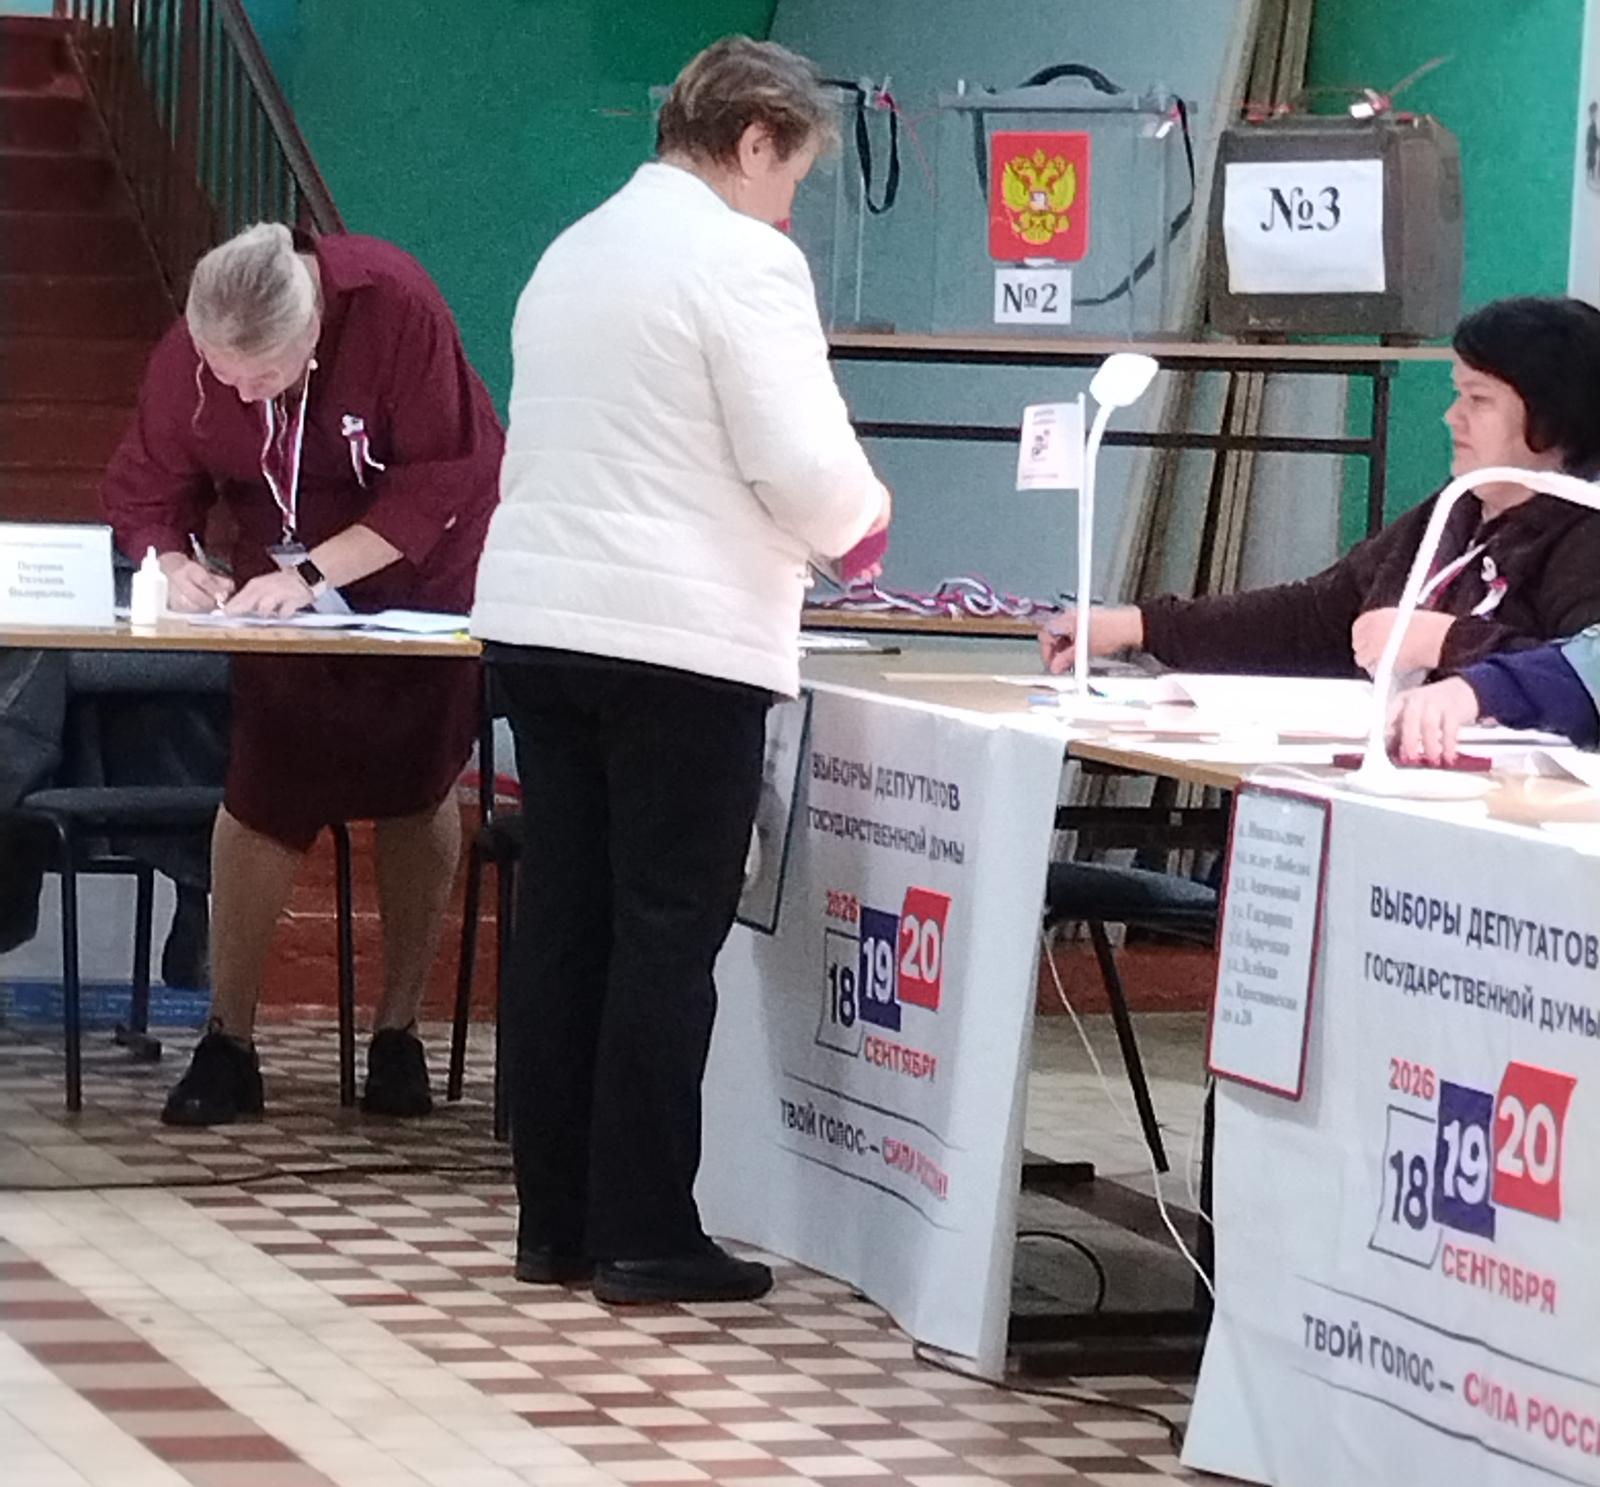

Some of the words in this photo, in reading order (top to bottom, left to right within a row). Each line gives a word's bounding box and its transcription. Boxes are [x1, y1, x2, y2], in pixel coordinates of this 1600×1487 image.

[1260, 186, 1342, 233] №3
[1002, 282, 1058, 314] №2
[812, 752, 873, 791] ВЫБОРЫ
[875, 766, 961, 812] ДЕПУТАТОВ
[807, 805, 926, 855] ГОСУДАРСТВЕННОЙ
[928, 834, 965, 865] ДУМЫ
[1370, 884, 1462, 937] ВЫБОРЫ
[1466, 907, 1599, 970] ДЕПУТАТОВ
[828, 963, 856, 1028] 18
[863, 936, 893, 1004] 19
[900, 915, 940, 984] 20
[1364, 952, 1534, 1023] ГОСУДАРСТВЕННОЙ
[1540, 997, 1600, 1040] ДУМЫ
[1388, 1057, 1435, 1101] 2026
[779, 1097, 817, 1136] ТВОЙ
[1389, 1150, 1429, 1231] 18
[1443, 1119, 1488, 1205] 19
[1496, 1095, 1557, 1185] 20
[1441, 1244, 1557, 1315] СЕНТЯБРЯ
[1303, 1313, 1364, 1364] ТВОЙ
[1369, 1334, 1435, 1392] ГОЛОС
[1463, 1372, 1519, 1427] СИЛА
[1527, 1397, 1600, 1457] РОСС
